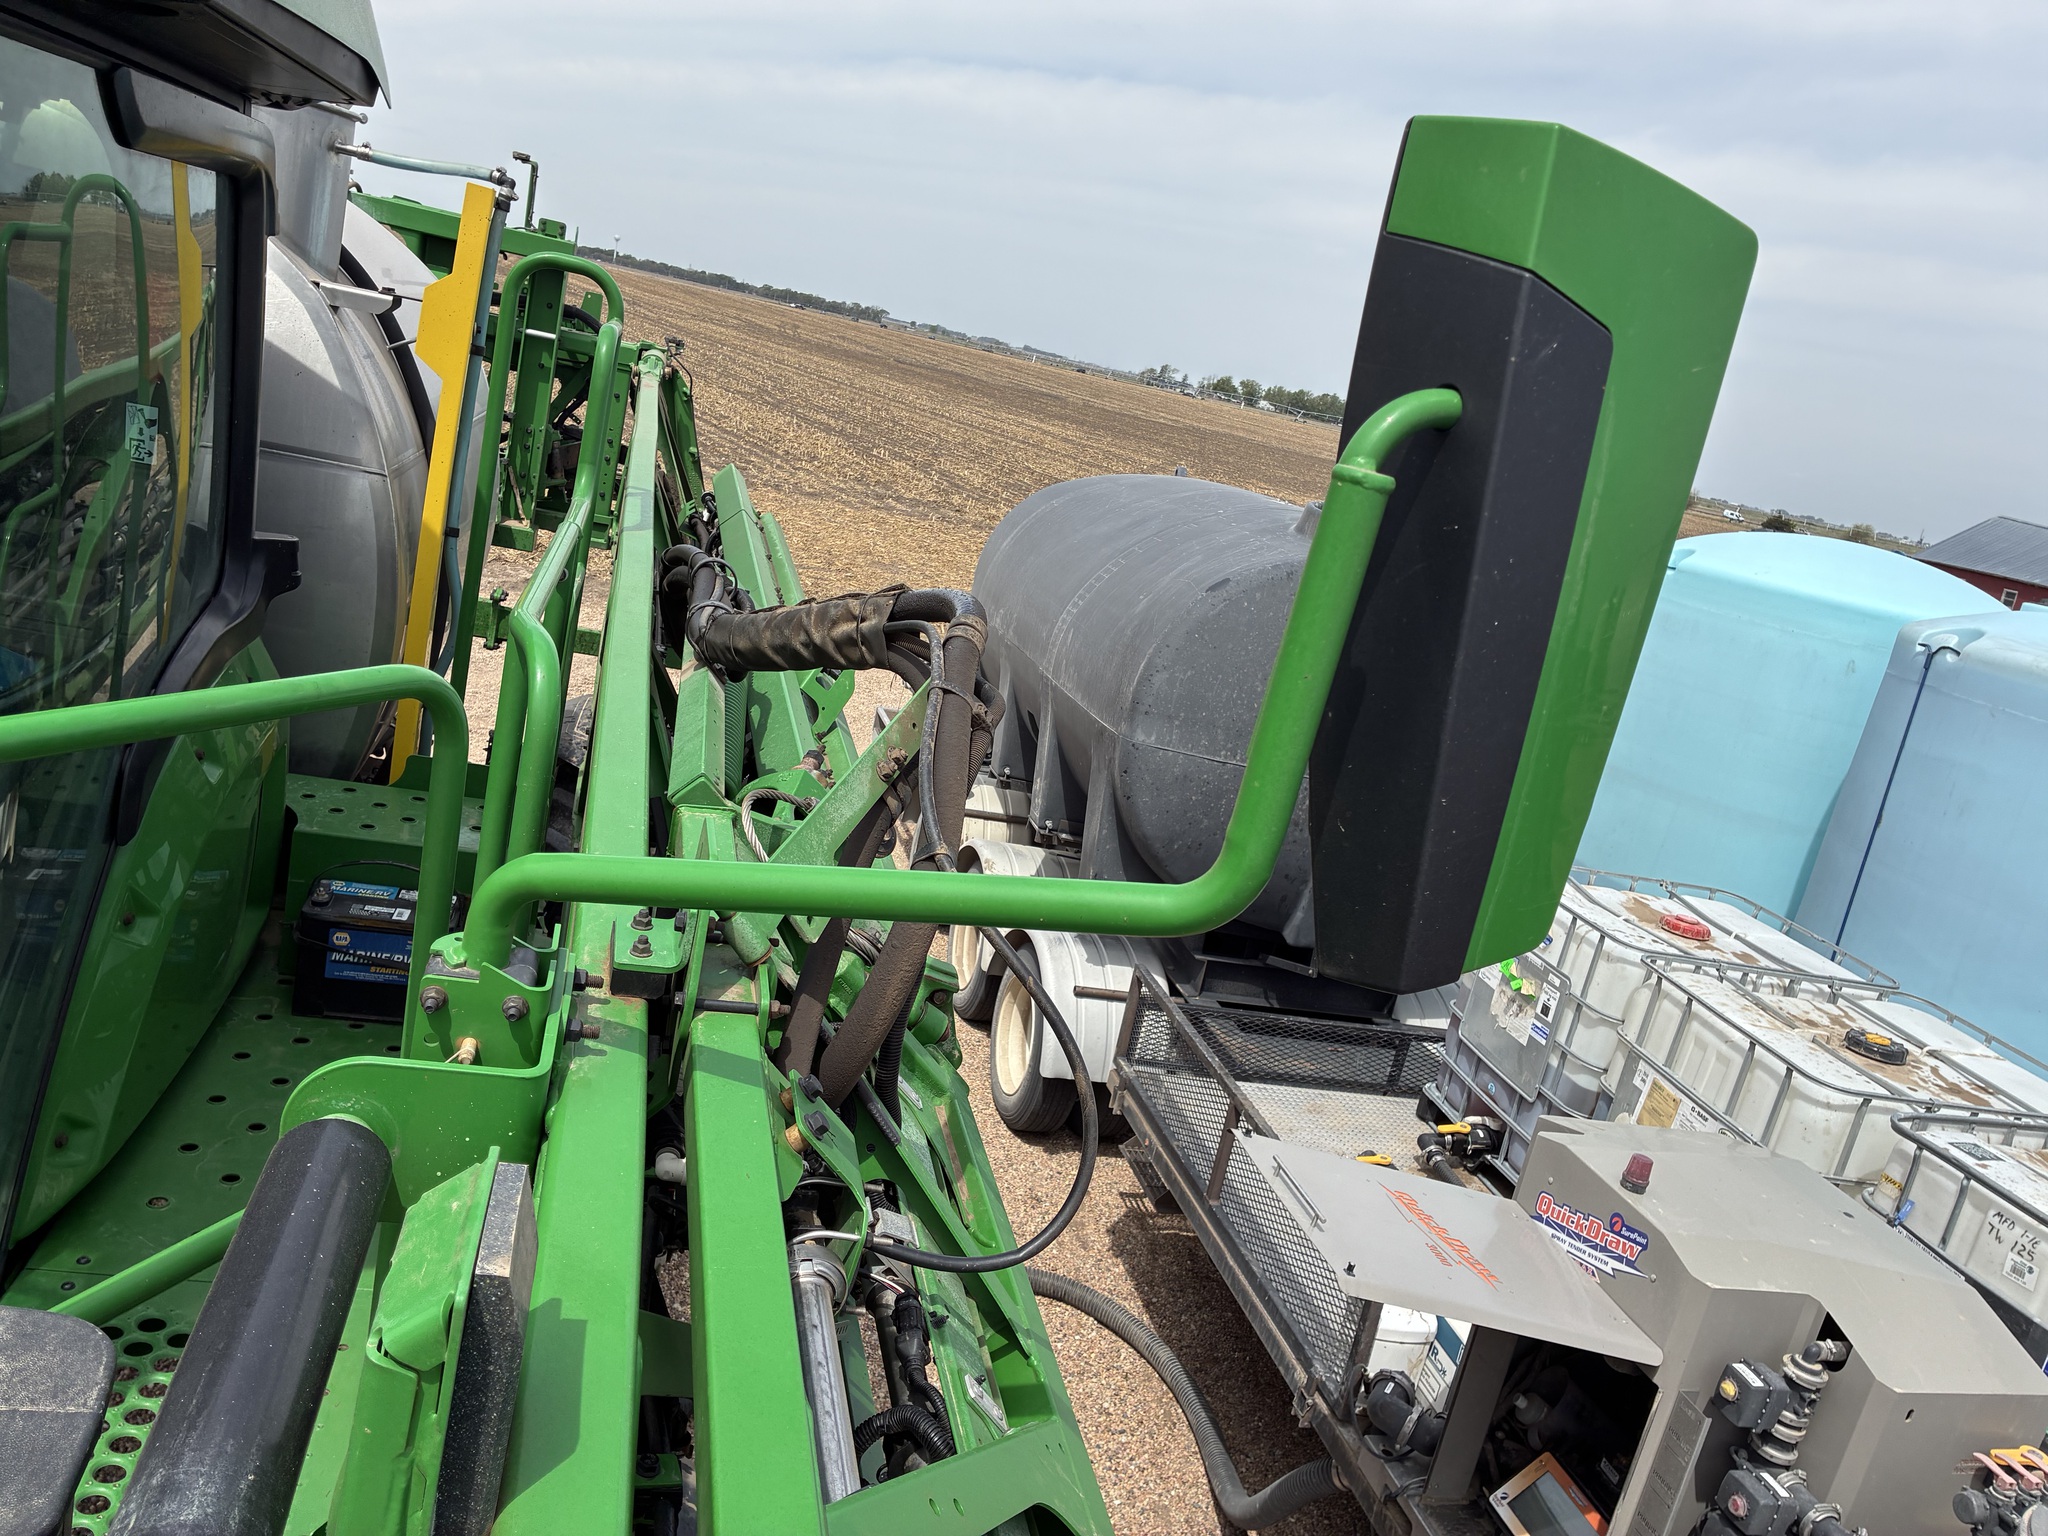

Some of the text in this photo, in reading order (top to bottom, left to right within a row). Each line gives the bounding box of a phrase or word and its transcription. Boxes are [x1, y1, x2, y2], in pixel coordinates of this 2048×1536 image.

[1536, 1193, 1641, 1260] QuickDraw
[1621, 1226, 1648, 1246] SurePoint
[1550, 1232, 1609, 1267] SPRAY TENDER SYSTEM
[2011, 1240, 2037, 1262] 125
